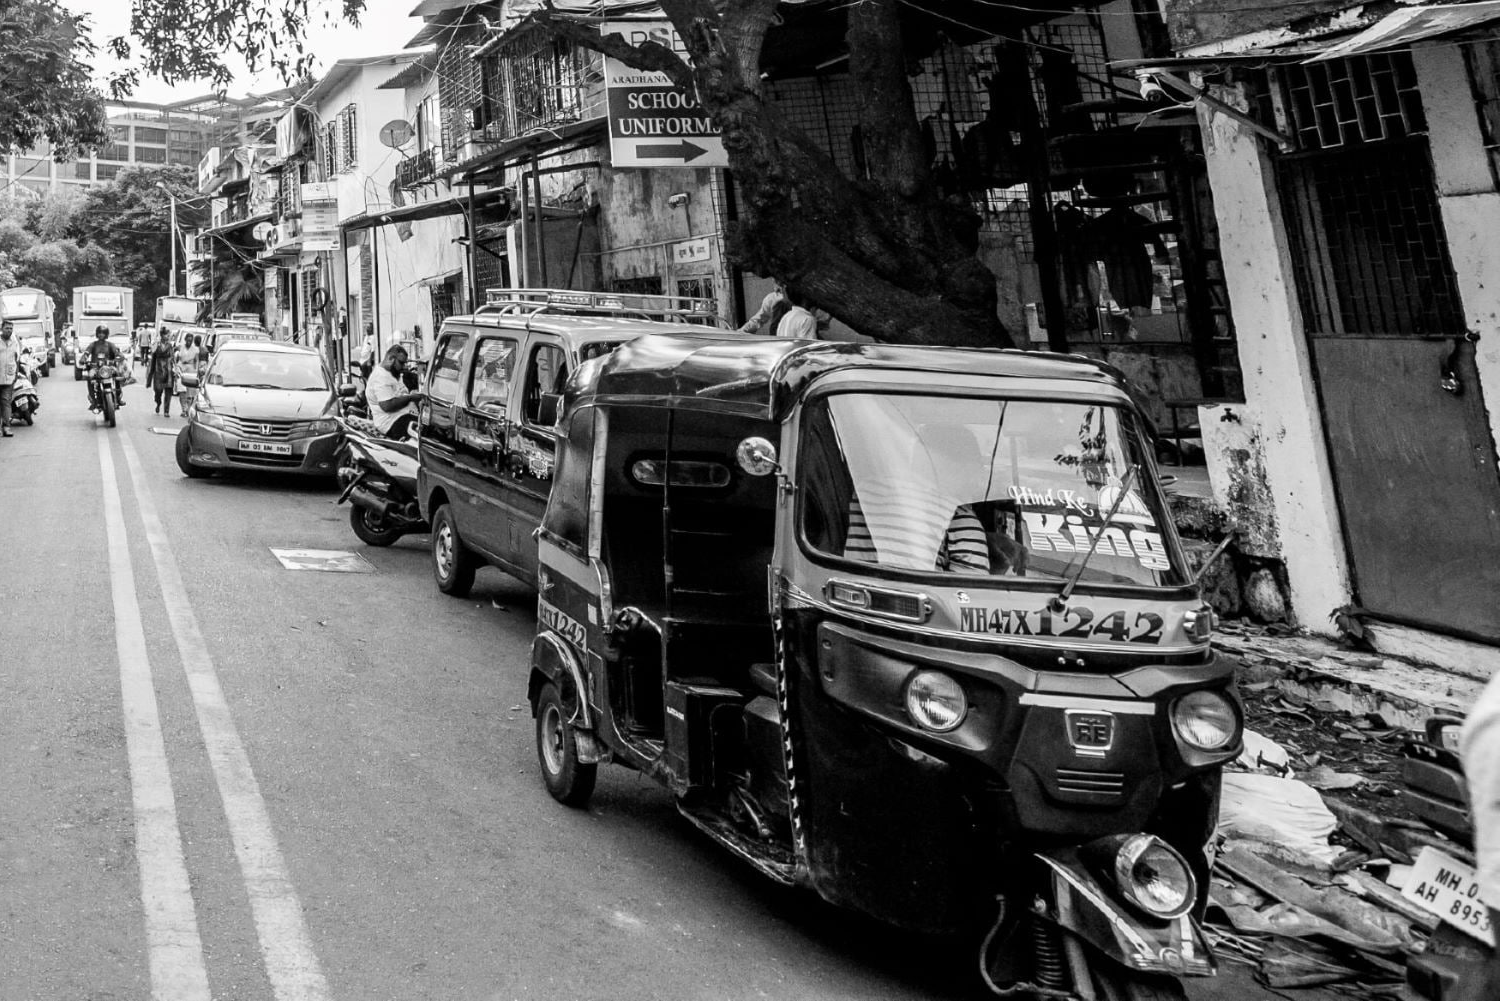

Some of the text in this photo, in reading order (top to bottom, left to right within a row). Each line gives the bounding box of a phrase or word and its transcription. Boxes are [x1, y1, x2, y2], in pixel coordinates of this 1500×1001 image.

[1007, 485, 1095, 518] Hind Ke
[1021, 511, 1171, 571] King
[1075, 722, 1107, 744] RE
